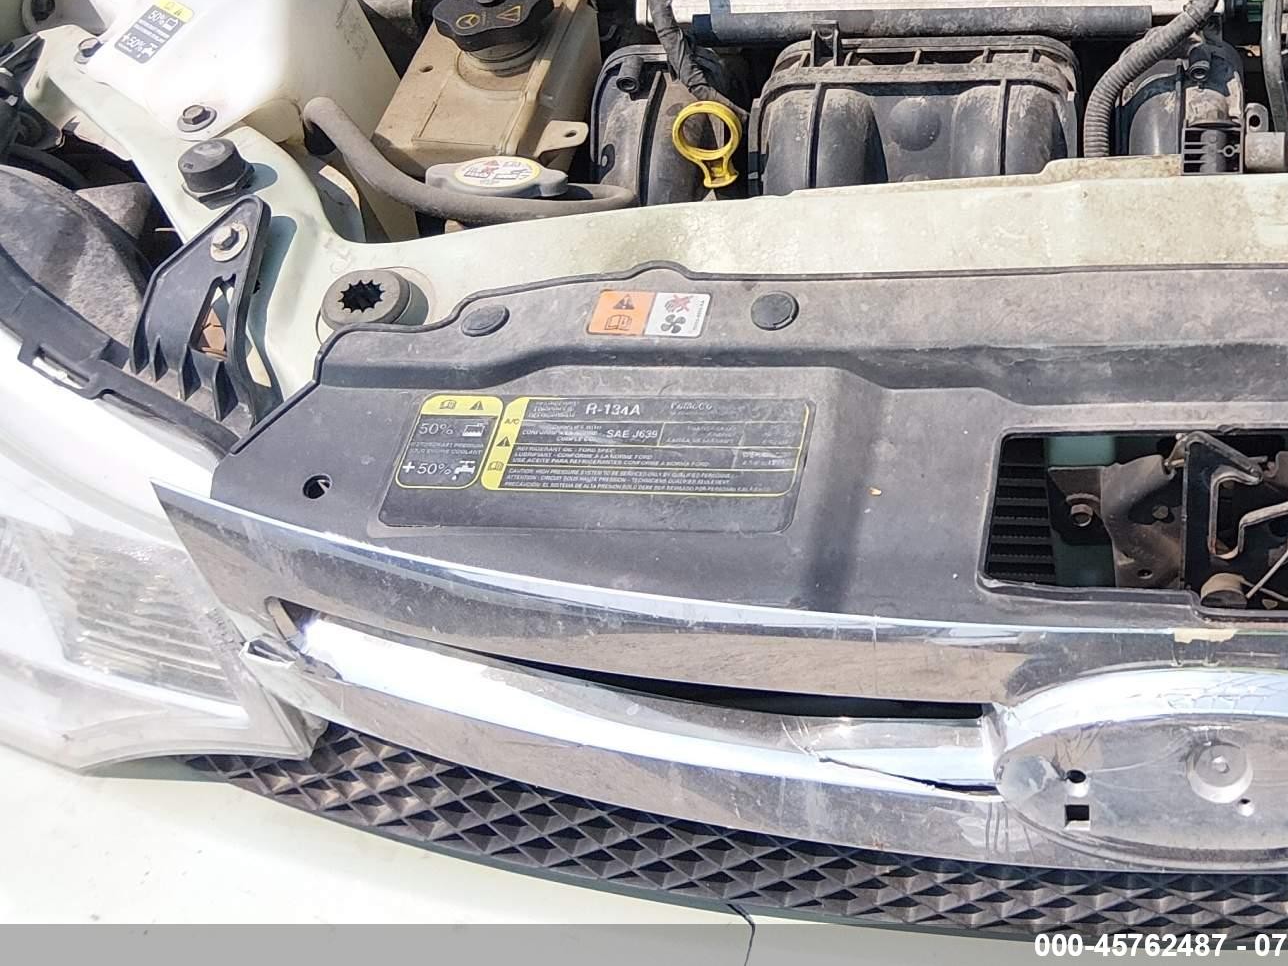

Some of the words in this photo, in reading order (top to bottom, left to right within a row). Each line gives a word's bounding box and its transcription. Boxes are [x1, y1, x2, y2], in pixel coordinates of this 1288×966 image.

[585, 402, 641, 415] R-134A
[418, 423, 454, 435] 50%
[605, 429, 630, 439] SAE
[632, 429, 658, 440] J639
